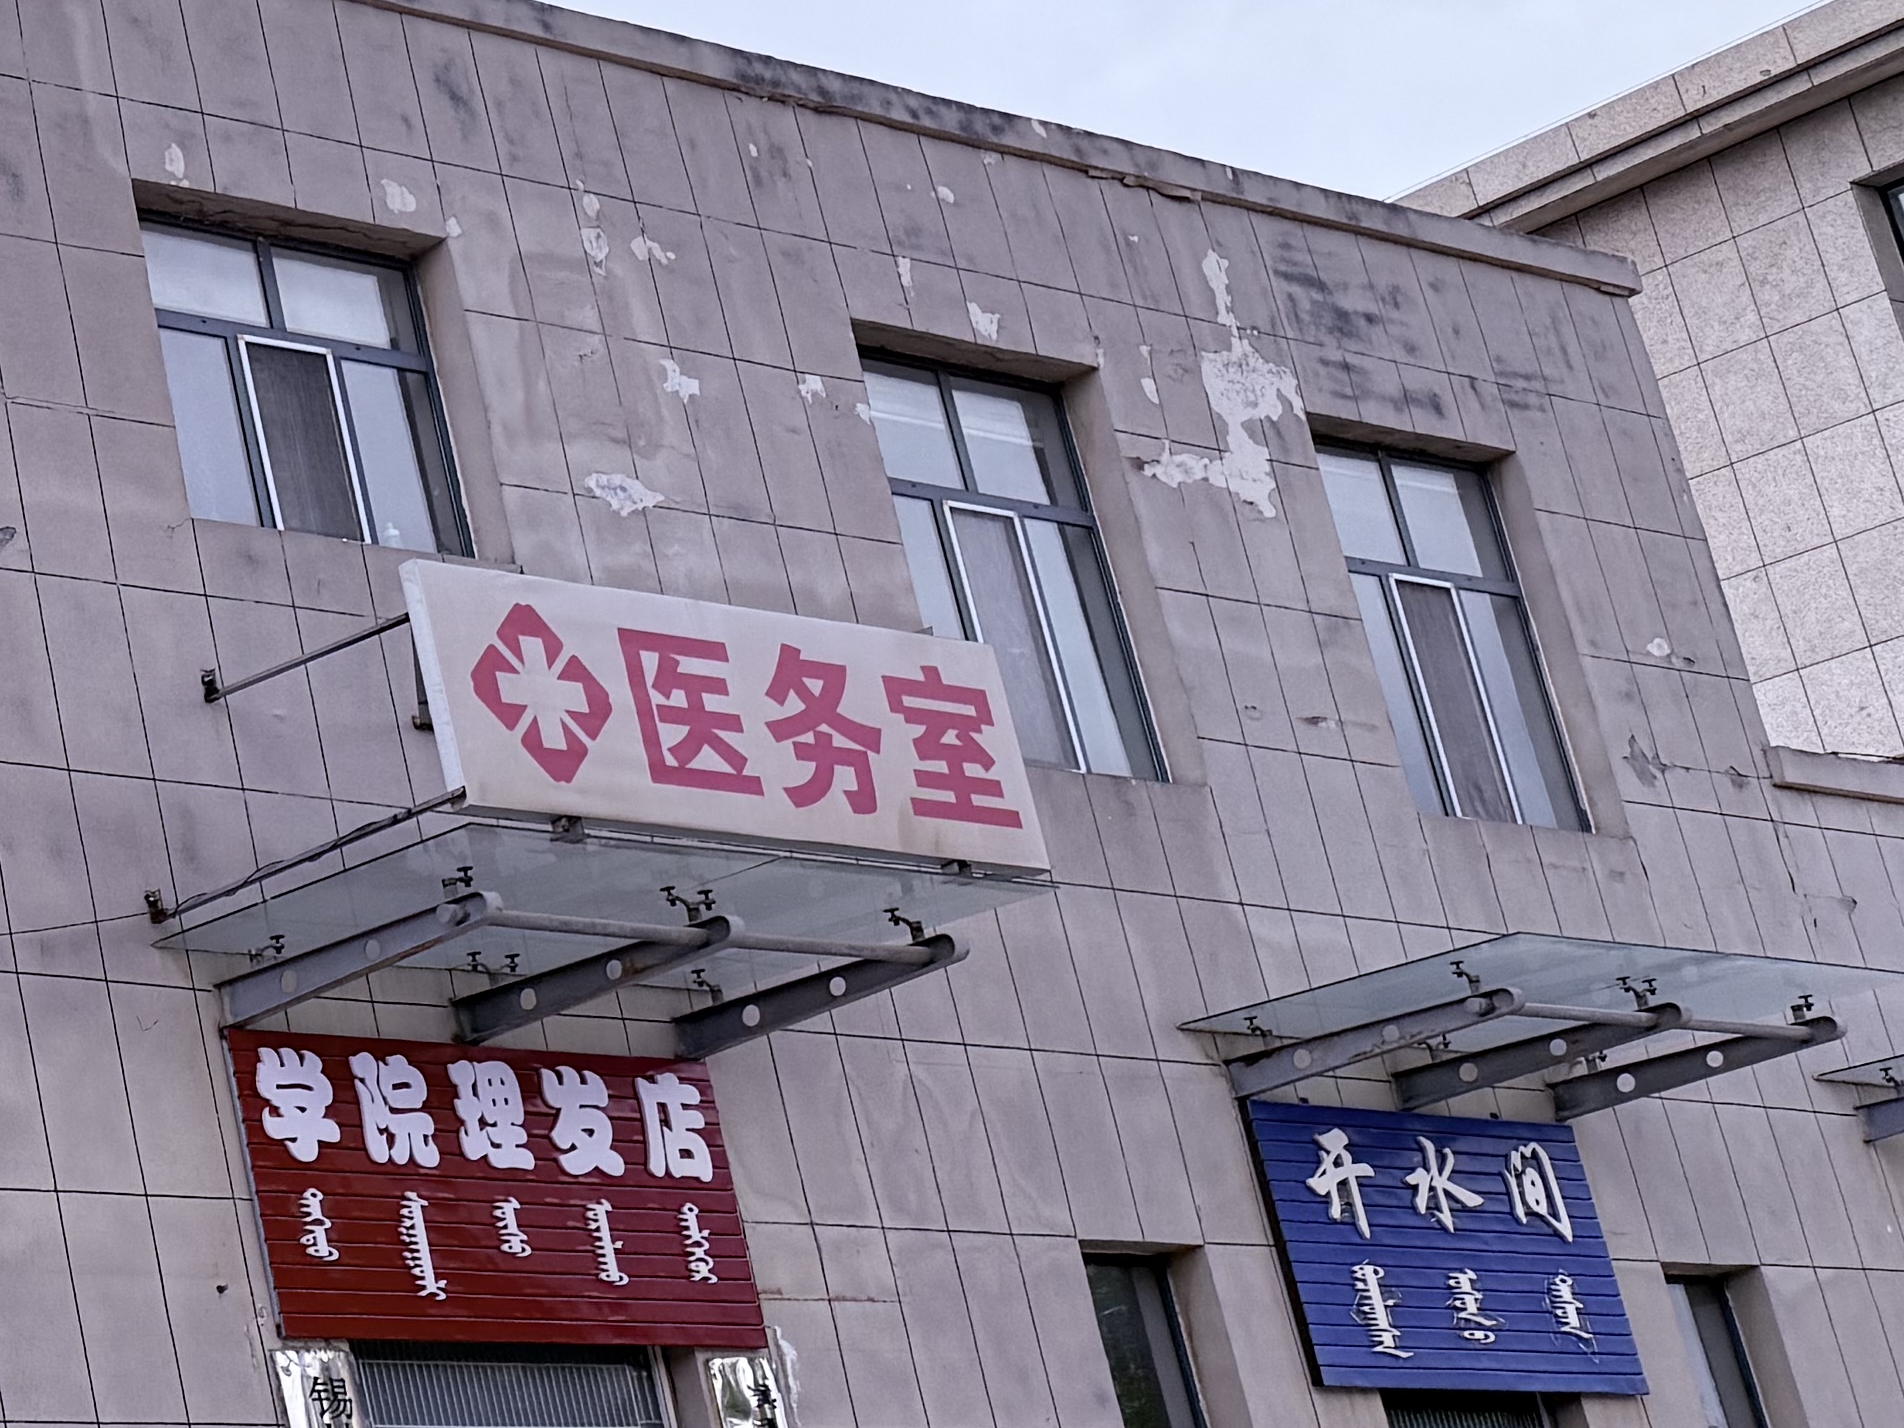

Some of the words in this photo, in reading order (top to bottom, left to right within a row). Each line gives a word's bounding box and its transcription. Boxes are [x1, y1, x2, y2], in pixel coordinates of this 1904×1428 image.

[617, 628, 1024, 830] 医务室
[255, 1047, 714, 1183] 学院理发店
[1306, 1127, 1574, 1243] 开水间
